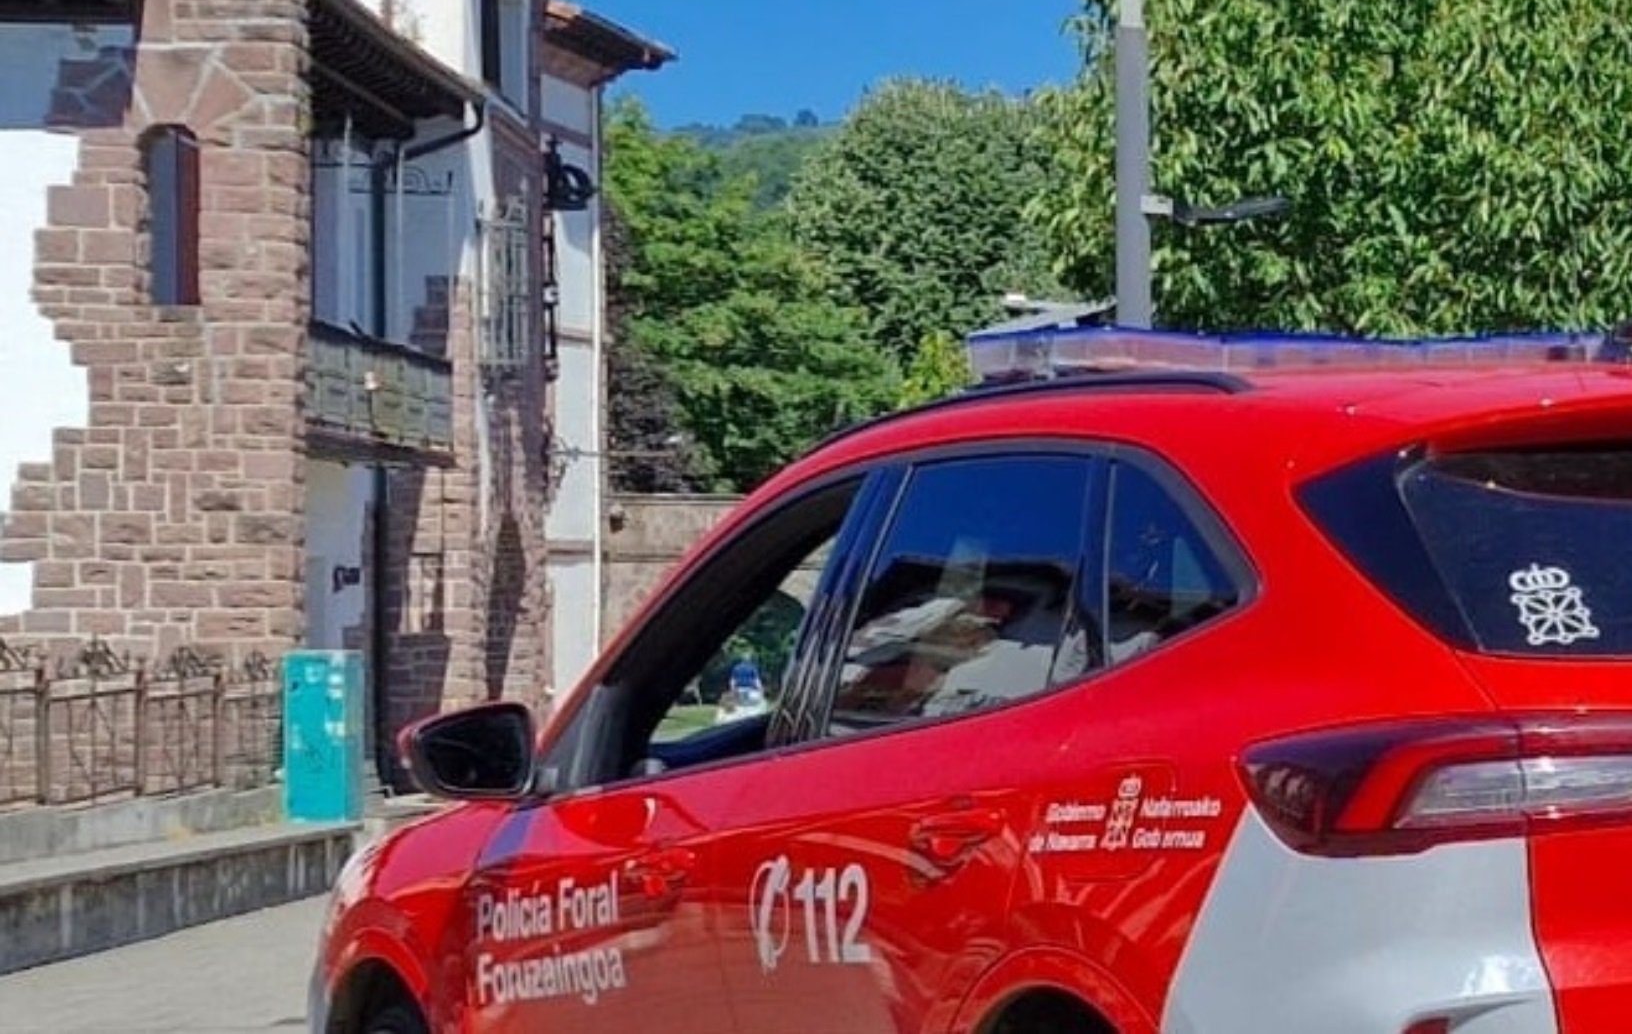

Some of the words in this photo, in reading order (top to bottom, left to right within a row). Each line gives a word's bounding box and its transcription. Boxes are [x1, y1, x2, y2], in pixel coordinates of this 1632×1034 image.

[477, 879, 551, 943] Policía
[558, 869, 619, 932] Foral
[793, 863, 872, 963] 112
[477, 946, 626, 1006] Foruzaingoa
